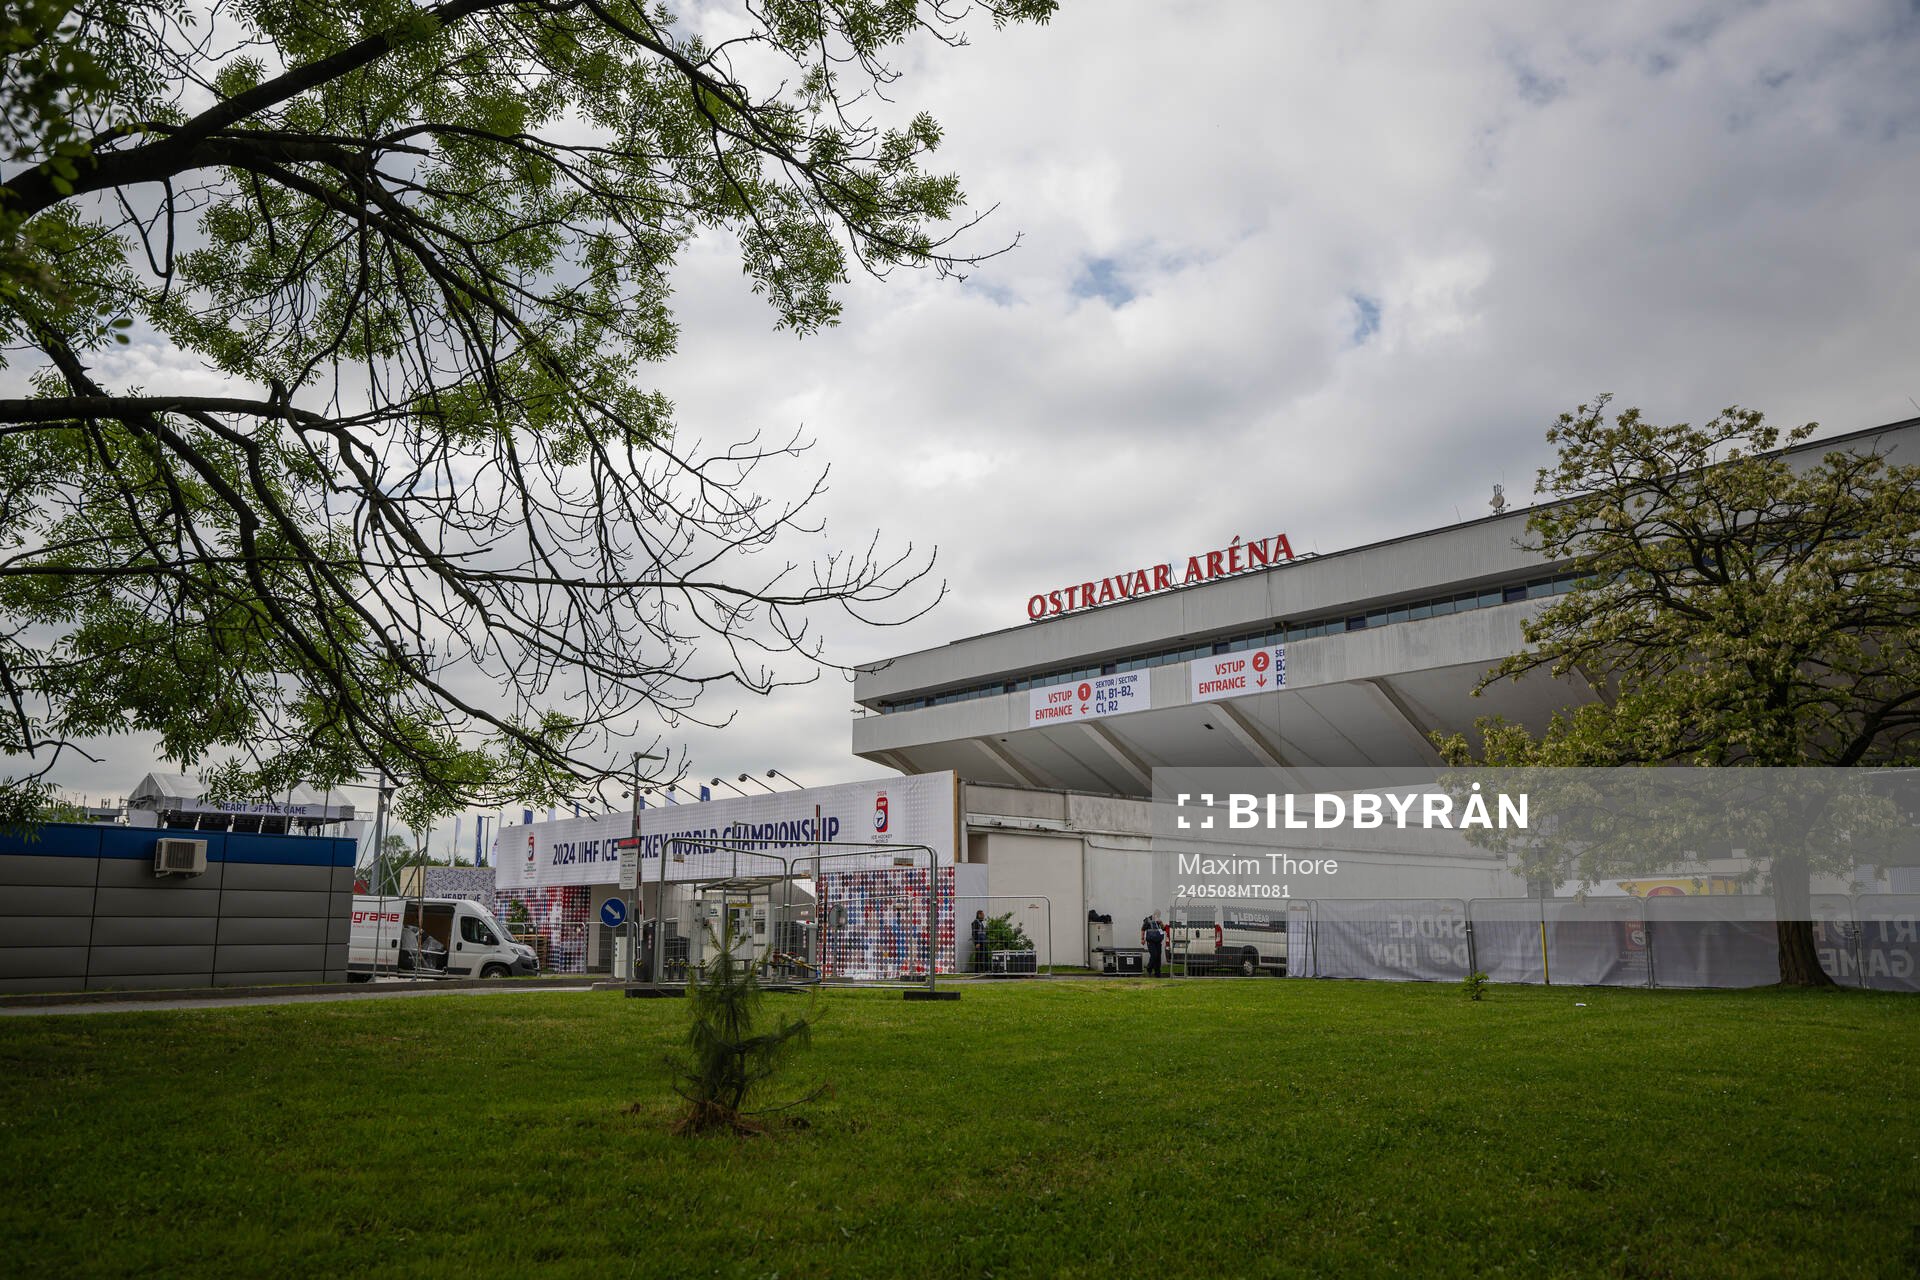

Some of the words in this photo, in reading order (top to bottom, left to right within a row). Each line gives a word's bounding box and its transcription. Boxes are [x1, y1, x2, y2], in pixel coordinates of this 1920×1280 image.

[1027, 563, 1171, 620] OSTRAVAR
[1184, 534, 1295, 584] ARÉNA
[1215, 660, 1245, 675] VSTUP
[1095, 679, 1115, 688] SEKTOR
[1118, 675, 1138, 684] SECTOR
[1199, 676, 1246, 694] ENTRANCE
[1048, 690, 1072, 703] VSTUP
[1095, 690, 1107, 702] A1,
[1108, 685, 1134, 699] B1-B2,
[1035, 705, 1073, 720] ENTRANCE
[1095, 703, 1107, 714] C1,
[1108, 701, 1118, 712] R2
[265, 804, 281, 813] THE
[283, 806, 307, 814] GAME
[552, 843, 576, 865] 2024
[579, 840, 599, 863] IIHF
[602, 838, 618, 861] ICE
[672, 828, 718, 855] WORLD
[723, 817, 840, 850] CHAMPIONSHIP
[352, 912, 400, 923] grafie
